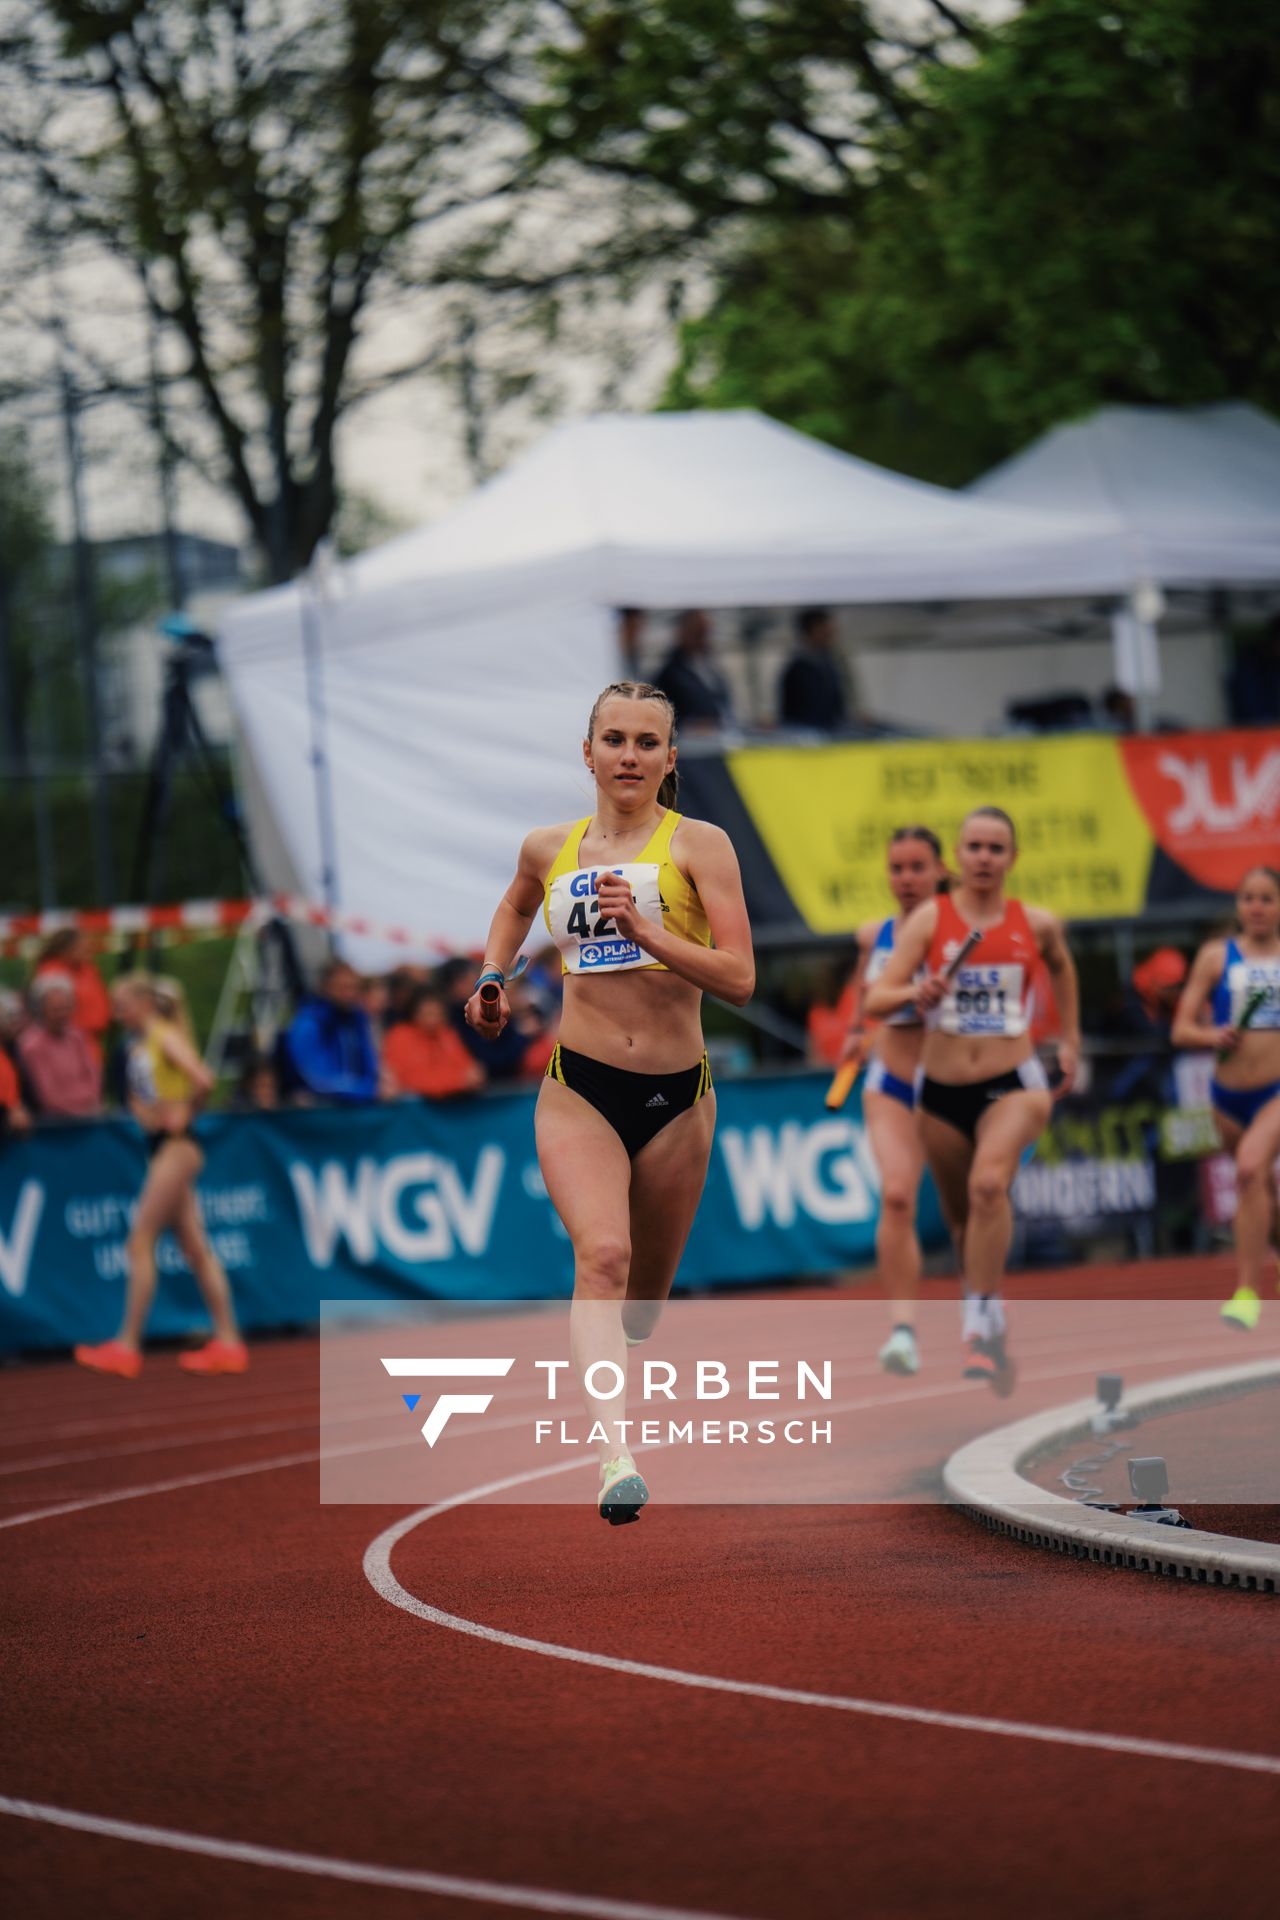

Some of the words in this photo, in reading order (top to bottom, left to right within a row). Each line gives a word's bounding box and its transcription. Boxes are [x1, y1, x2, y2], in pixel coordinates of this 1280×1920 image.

[567, 895, 636, 939] 42
[603, 942, 637, 957] PLAN
[290, 1142, 506, 1268] WGV
